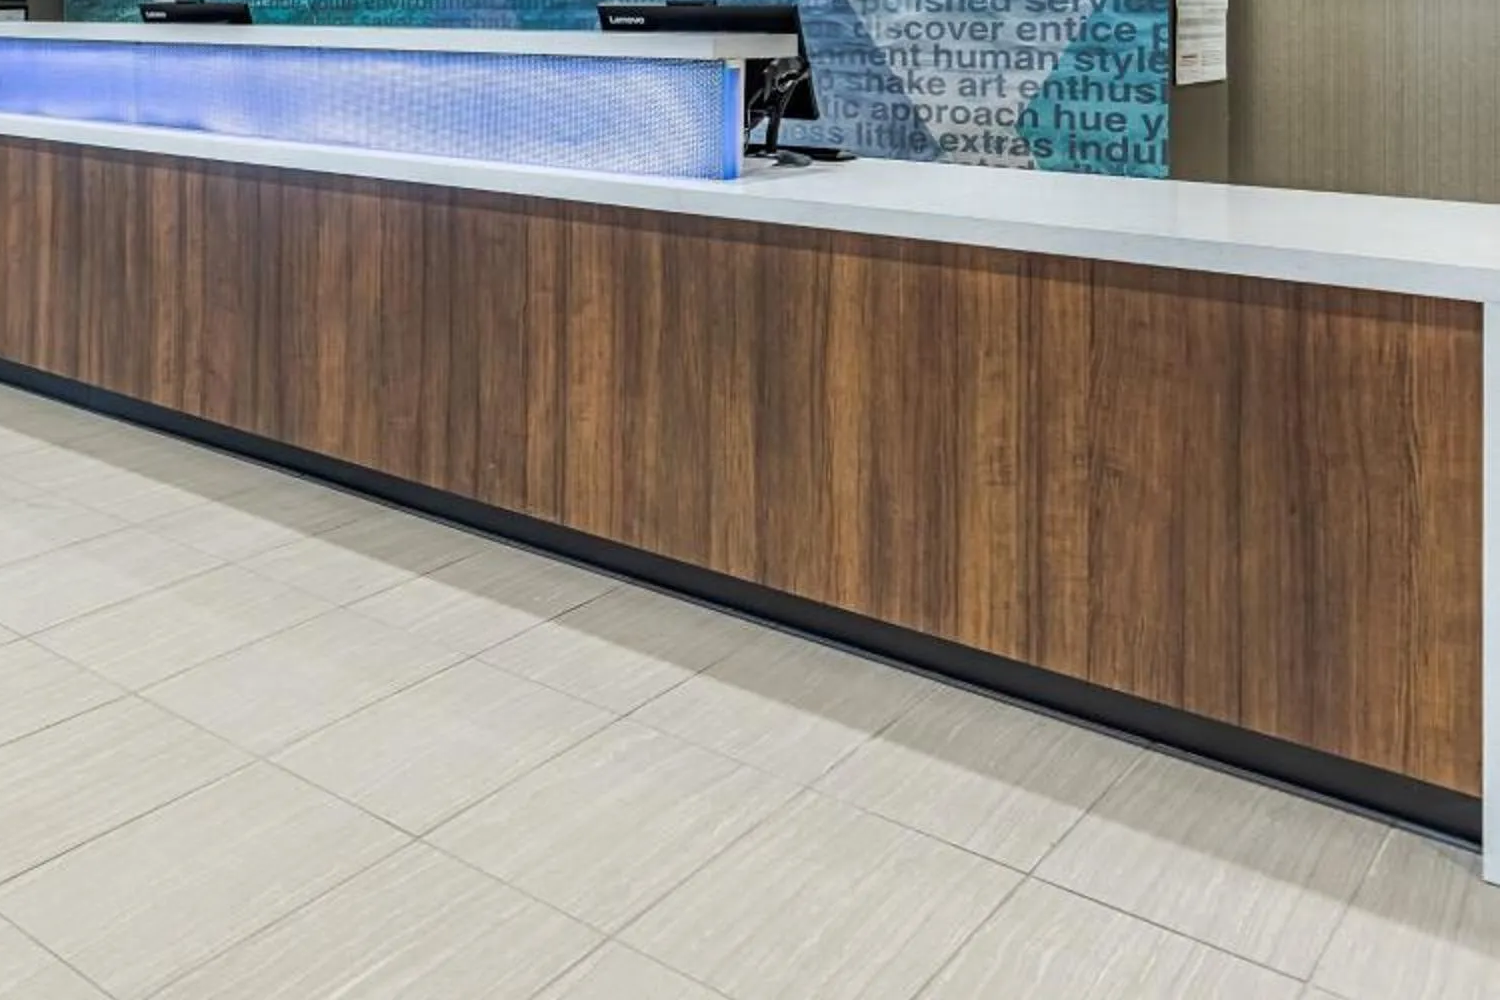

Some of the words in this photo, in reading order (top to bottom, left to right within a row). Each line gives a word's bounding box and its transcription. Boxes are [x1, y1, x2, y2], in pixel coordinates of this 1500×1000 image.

[608, 15, 645, 25] Lenovo
[1016, 14, 1137, 41] entice
[933, 41, 1059, 69] human
[847, 67, 947, 94] shake
[959, 73, 1006, 96] art
[870, 99, 1039, 127] approach
[1053, 102, 1127, 131] hue
[856, 120, 927, 148] little
[939, 129, 1054, 156] extras
